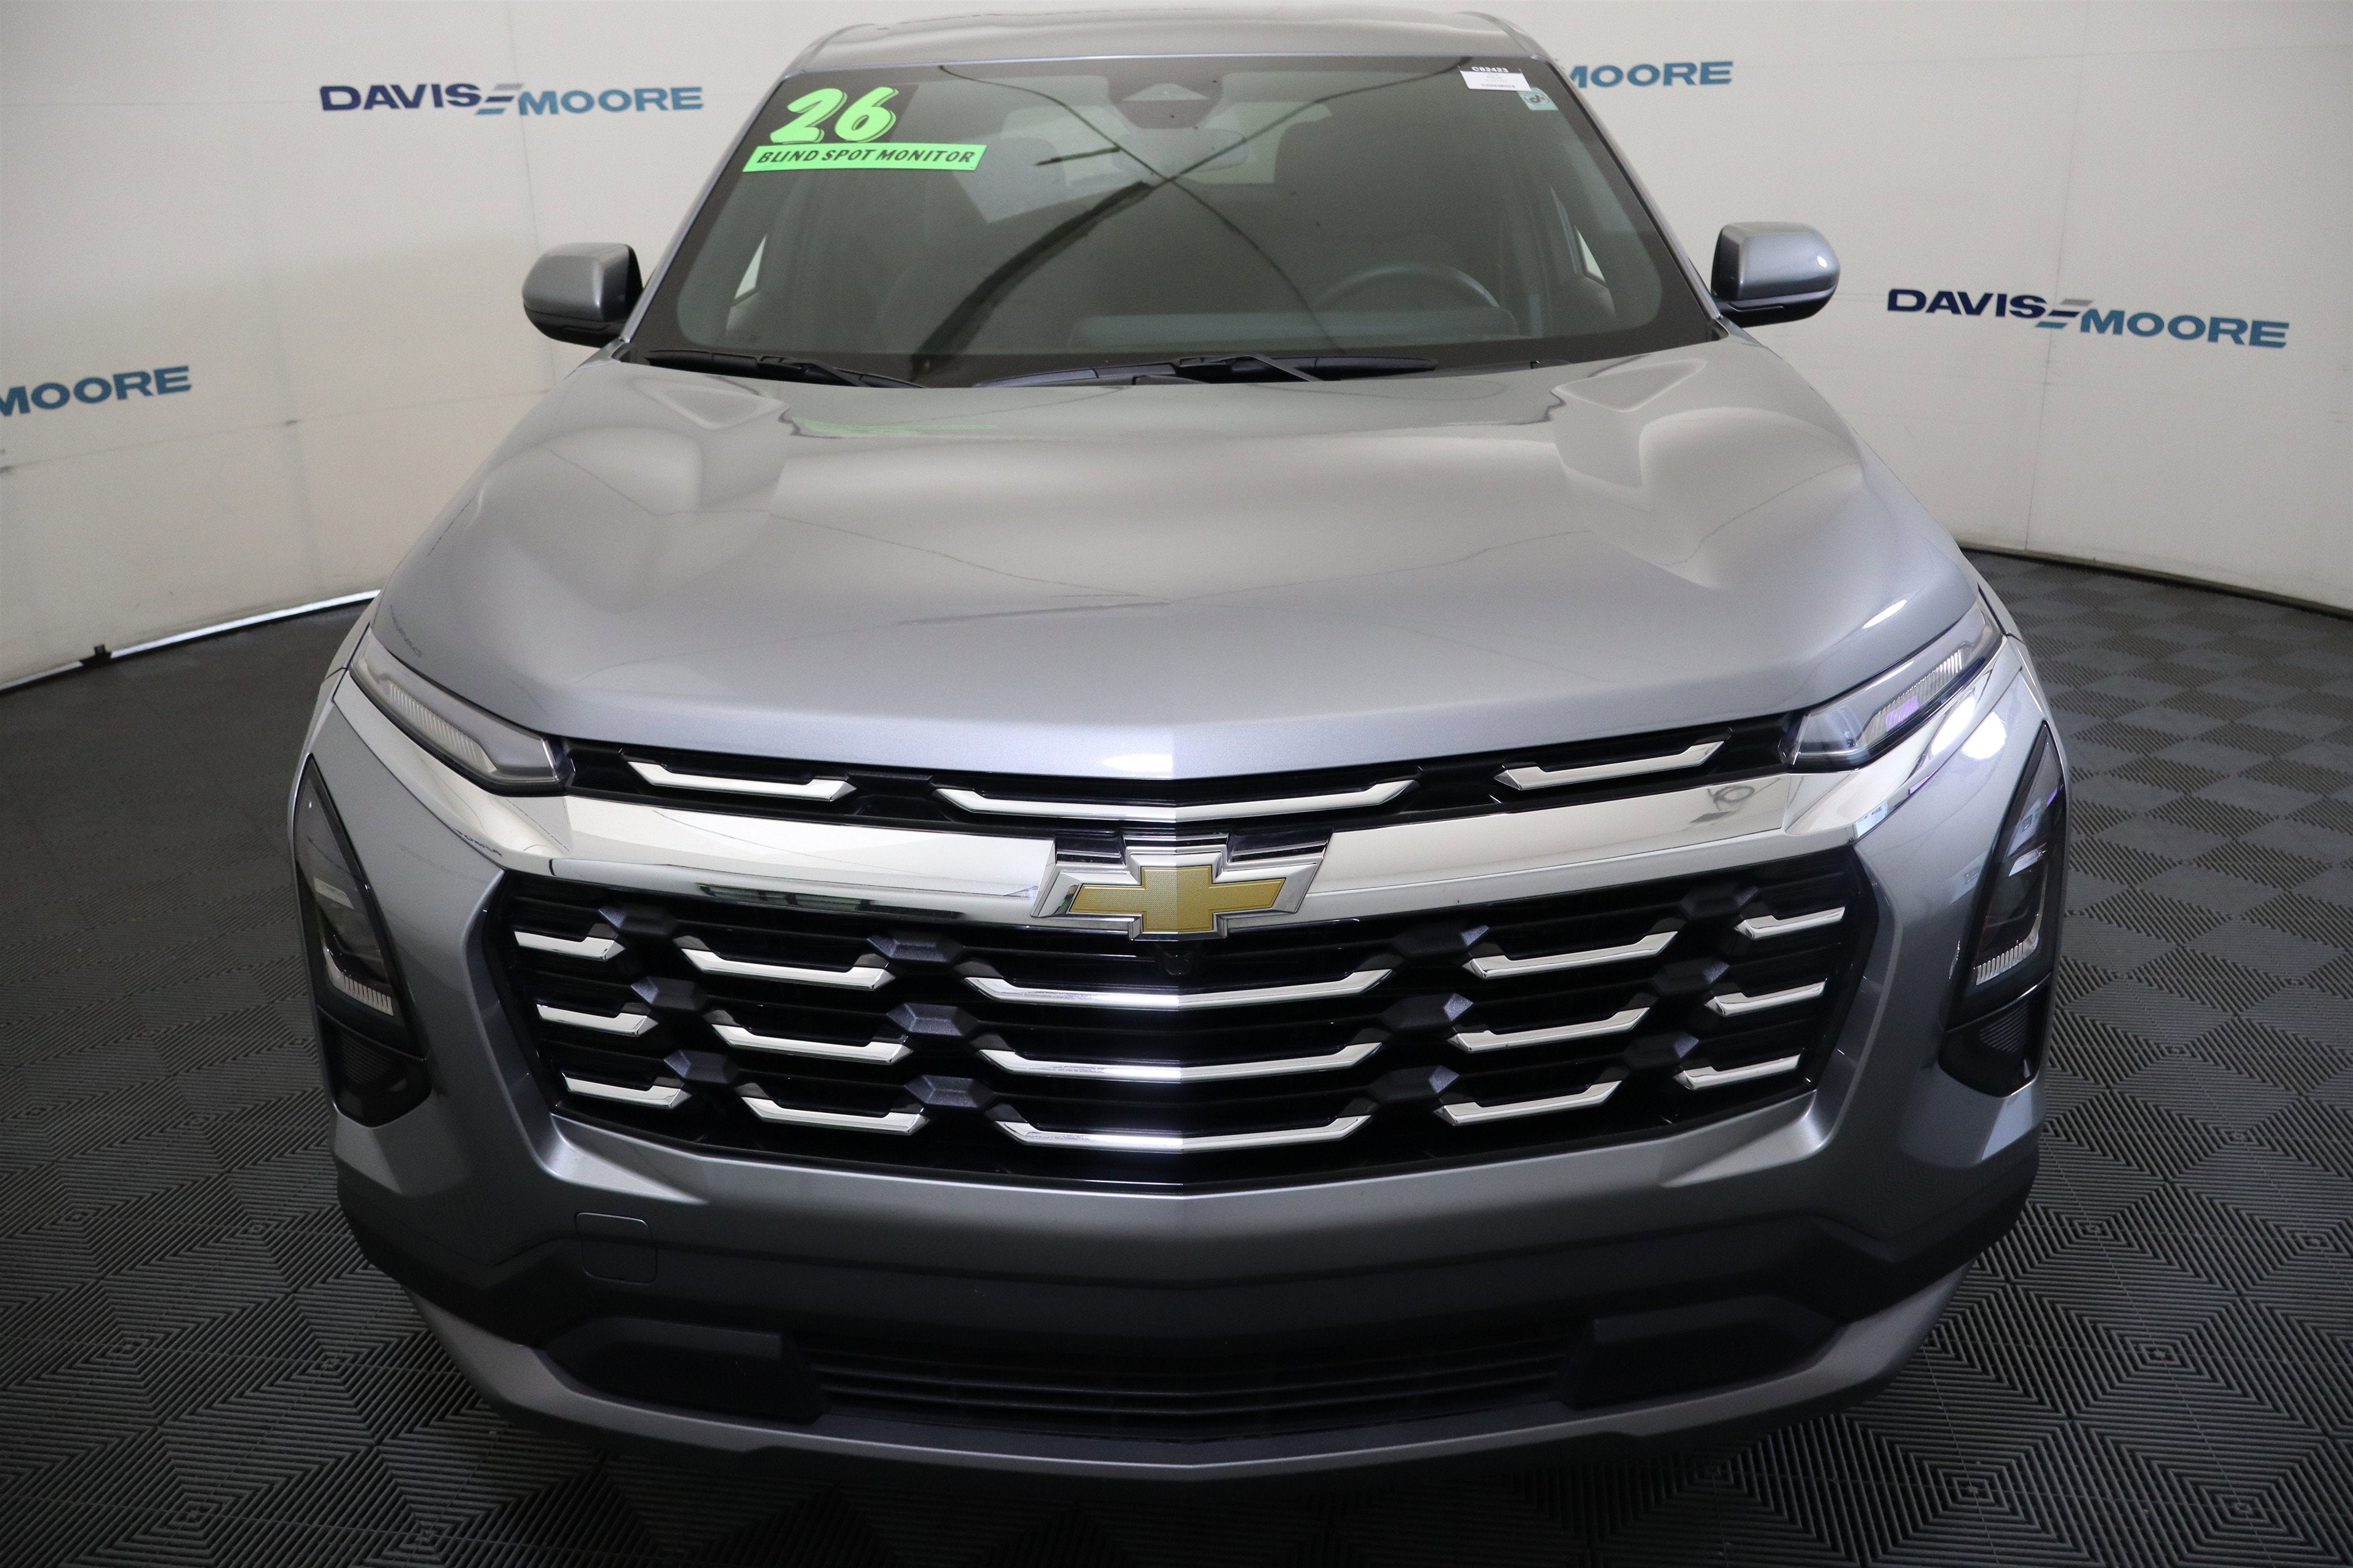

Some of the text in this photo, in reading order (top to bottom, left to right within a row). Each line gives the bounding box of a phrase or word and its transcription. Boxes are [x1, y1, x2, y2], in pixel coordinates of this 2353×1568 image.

[319, 83, 703, 115] DAVIS MOORE
[770, 86, 899, 145] 26
[757, 149, 976, 164] BLIND SPOT MONITOR
[1887, 288, 2290, 349] DAVIS MOORE
